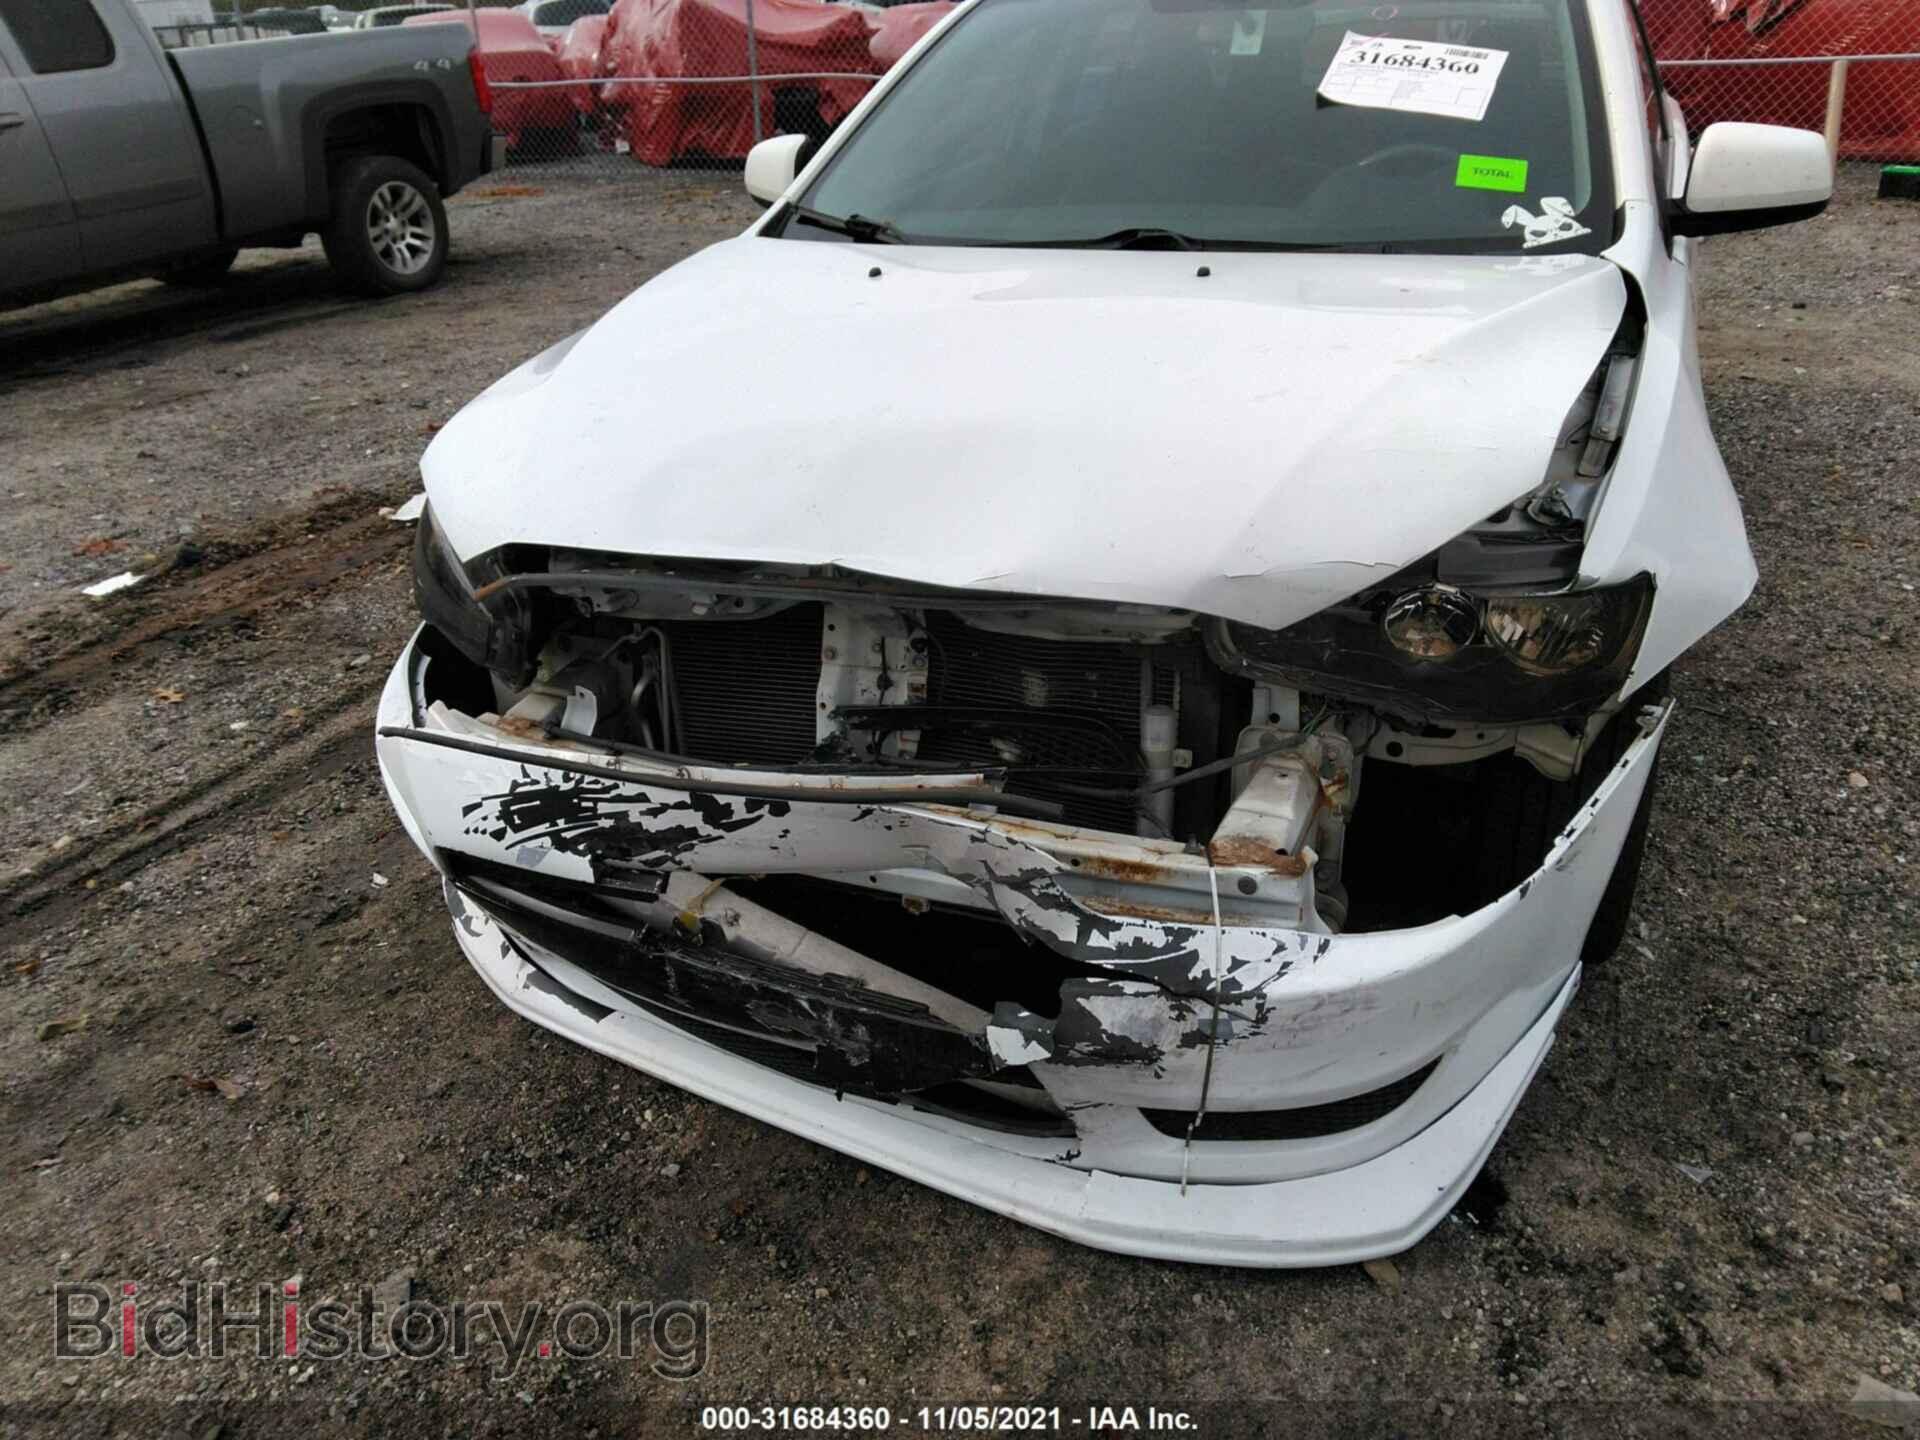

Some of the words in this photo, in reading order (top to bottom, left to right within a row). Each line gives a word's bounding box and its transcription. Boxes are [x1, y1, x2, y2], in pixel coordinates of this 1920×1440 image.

[413, 58, 451, 71] 44
[1350, 50, 1480, 74] 31684360
[1473, 167, 1512, 178] TOTAL
